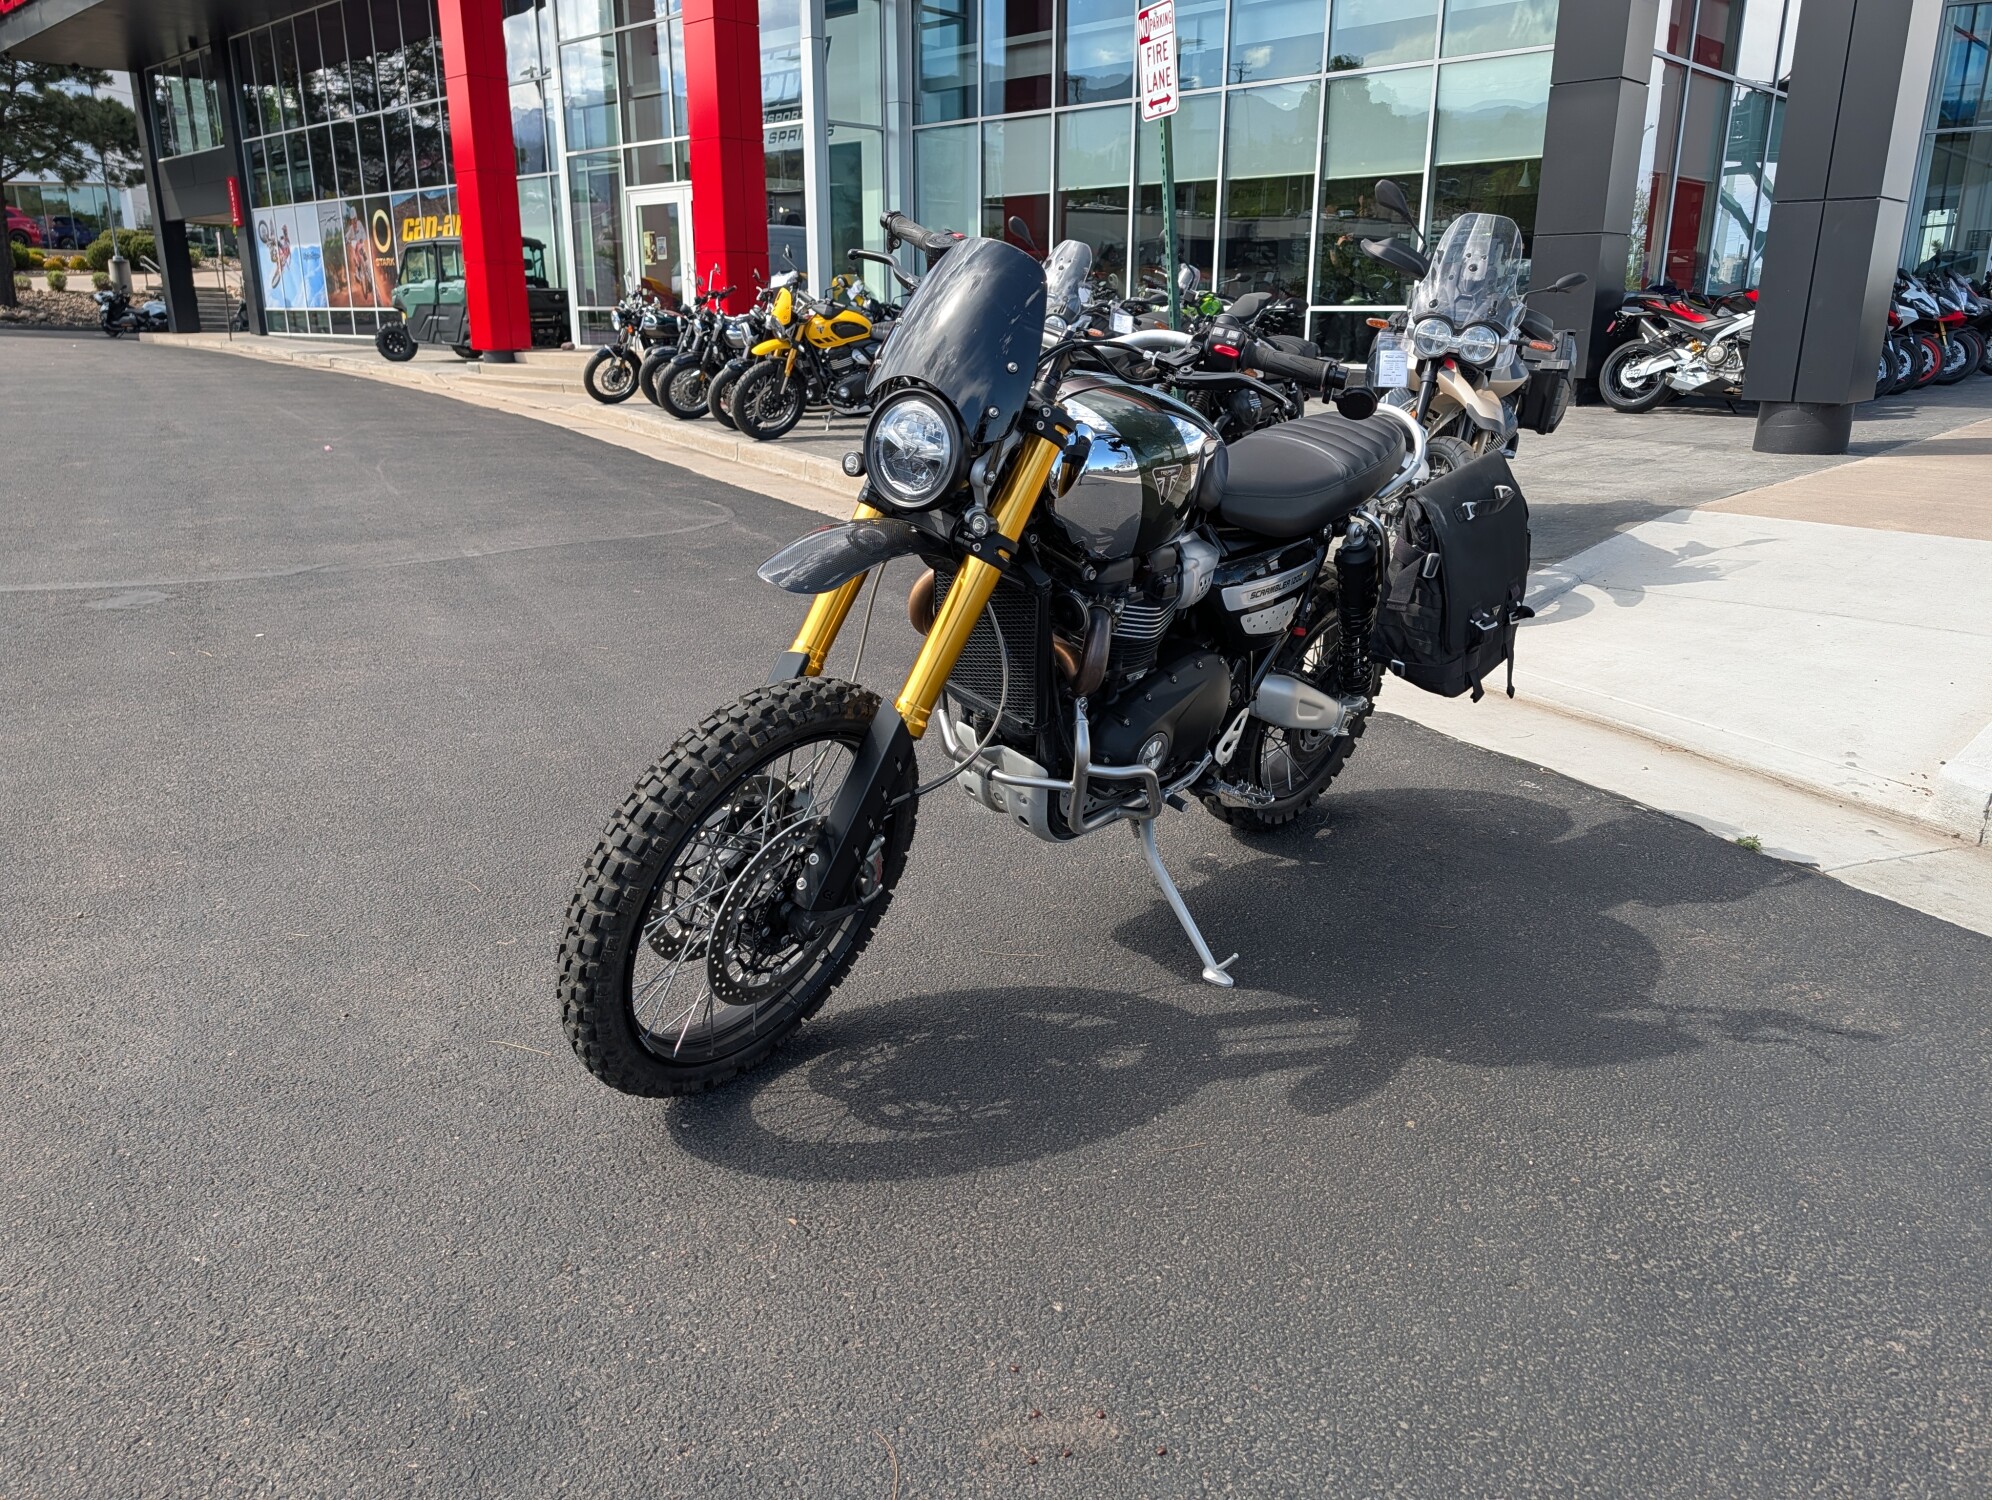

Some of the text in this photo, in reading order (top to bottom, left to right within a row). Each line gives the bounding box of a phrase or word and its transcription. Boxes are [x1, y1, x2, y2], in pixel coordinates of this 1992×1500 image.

[1140, 10, 1172, 39] NO PARKING
[1147, 40, 1168, 67] FIRE
[1147, 66, 1172, 93] LANE
[762, 110, 803, 124] SPORT
[375, 257, 395, 267] STARK
[1250, 580, 1290, 599] SCRAMBLER
